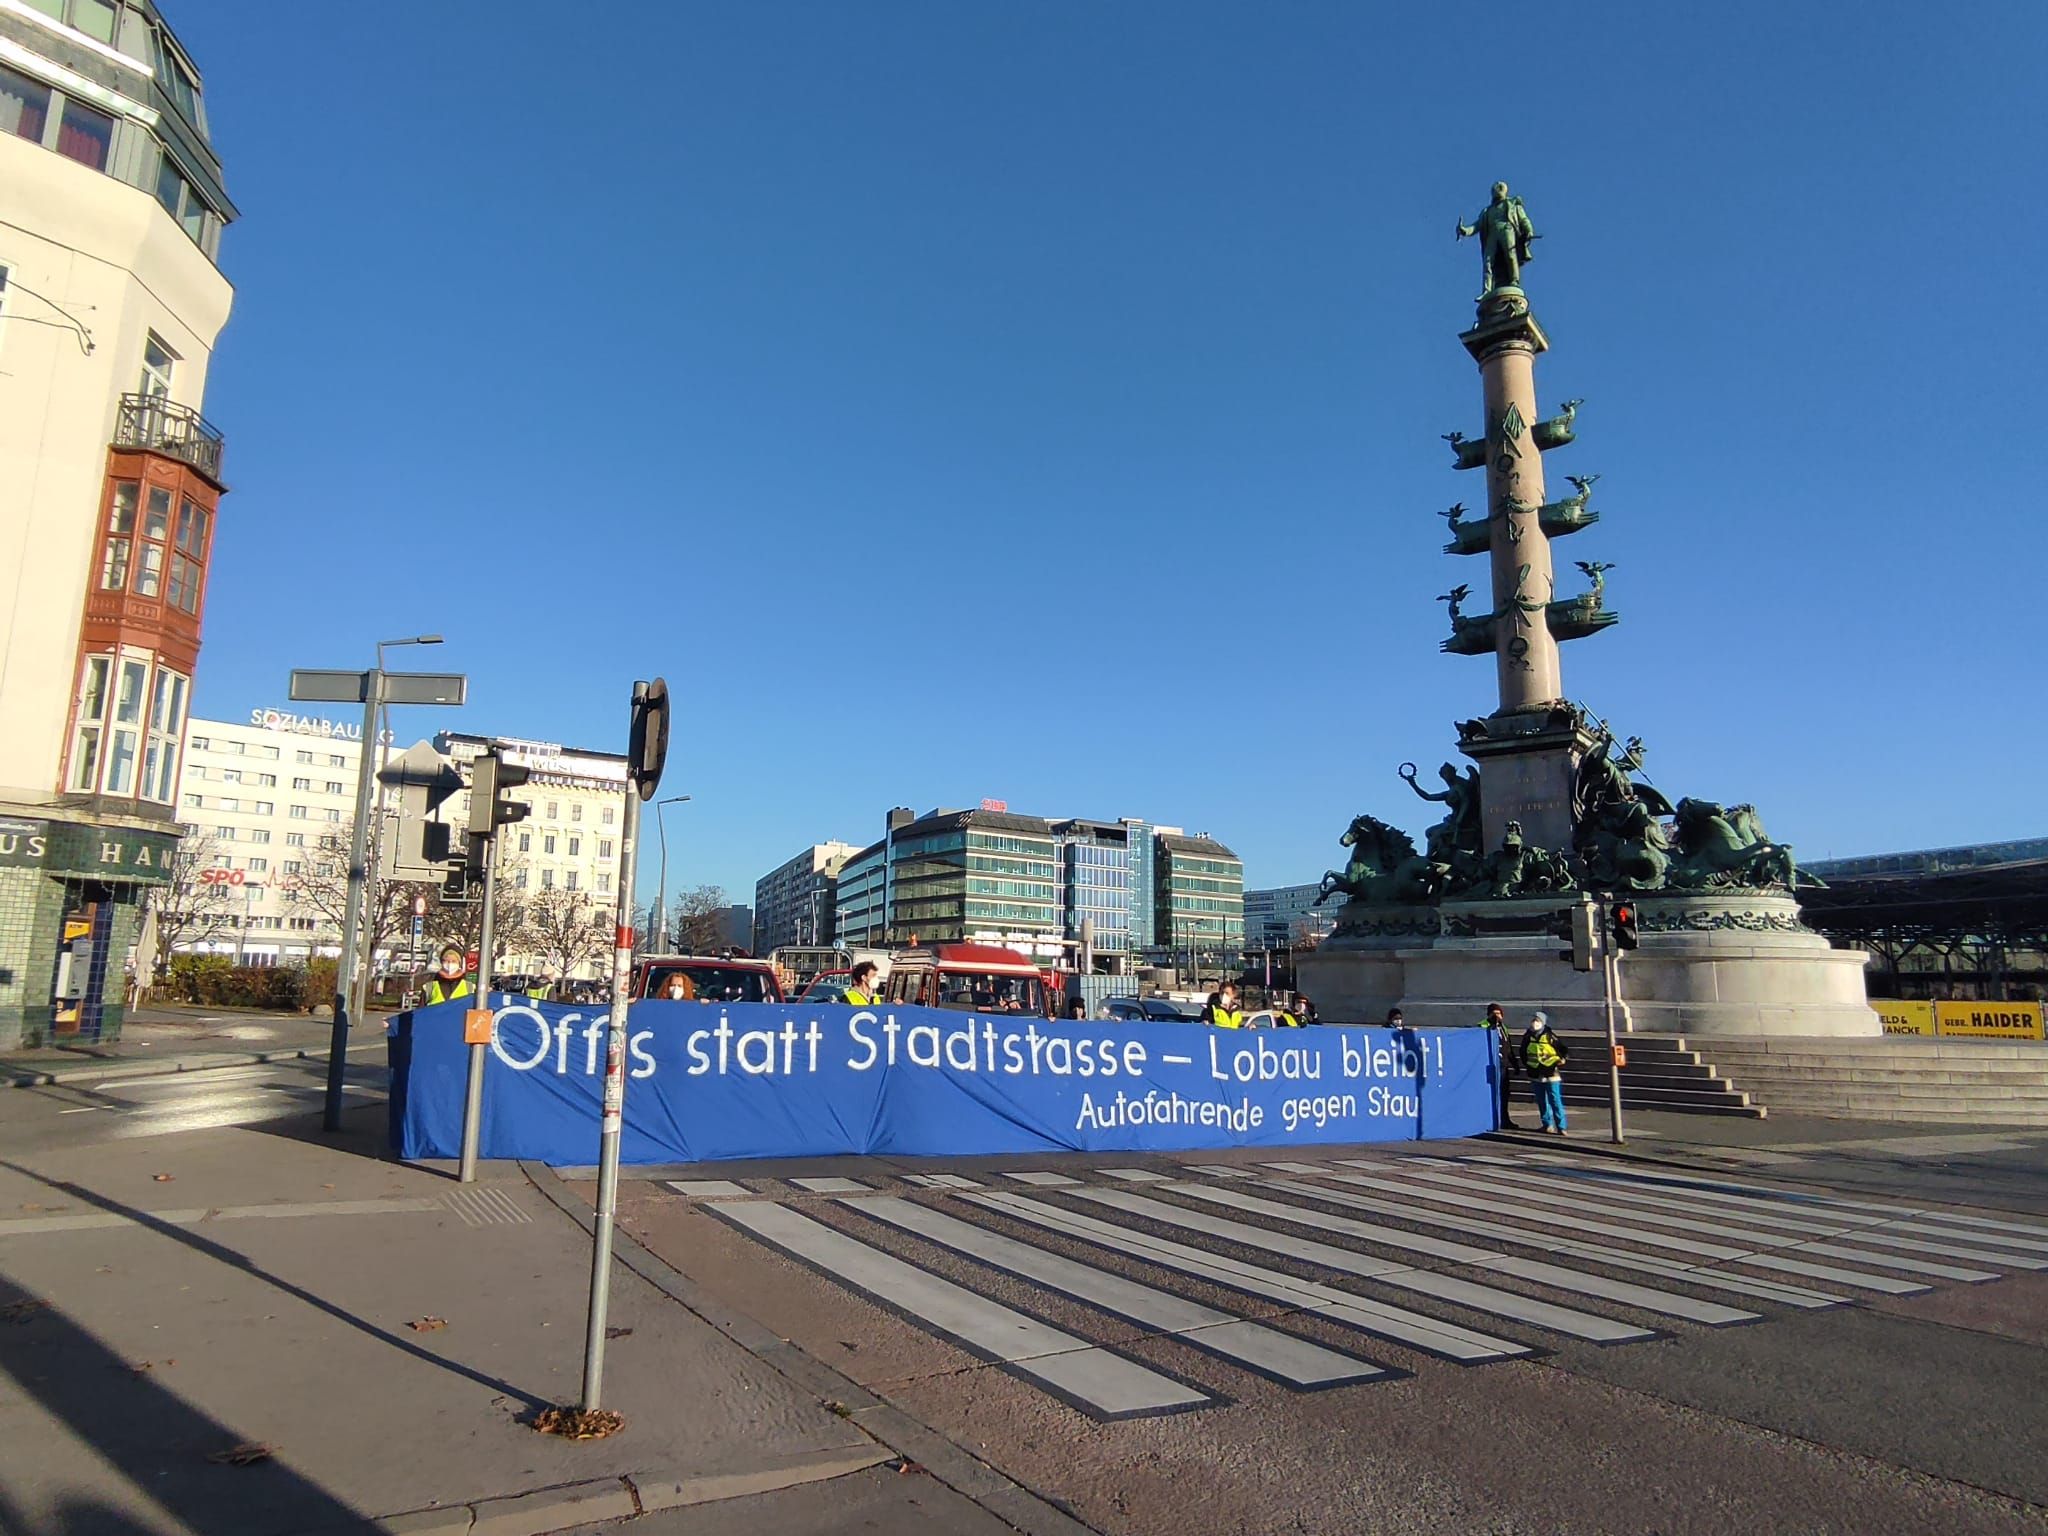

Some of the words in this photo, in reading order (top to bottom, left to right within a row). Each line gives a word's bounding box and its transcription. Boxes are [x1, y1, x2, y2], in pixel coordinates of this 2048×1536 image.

[251, 708, 361, 739] SOZIALBAU
[200, 868, 246, 886] SPÖ
[1881, 1015, 1899, 1024] ELD
[1971, 1012, 2033, 1029] HAIDER
[490, 995, 657, 1078] Öffs
[686, 1015, 823, 1076] statt
[847, 1010, 1147, 1078] Stadtstrasse
[1208, 1034, 1321, 1082] Lobau
[1341, 1034, 1444, 1078] bleibt!
[1075, 1089, 1264, 1132] Autofahrende
[1281, 1093, 1356, 1132] gegen
[1367, 1085, 1419, 1118] Stau
